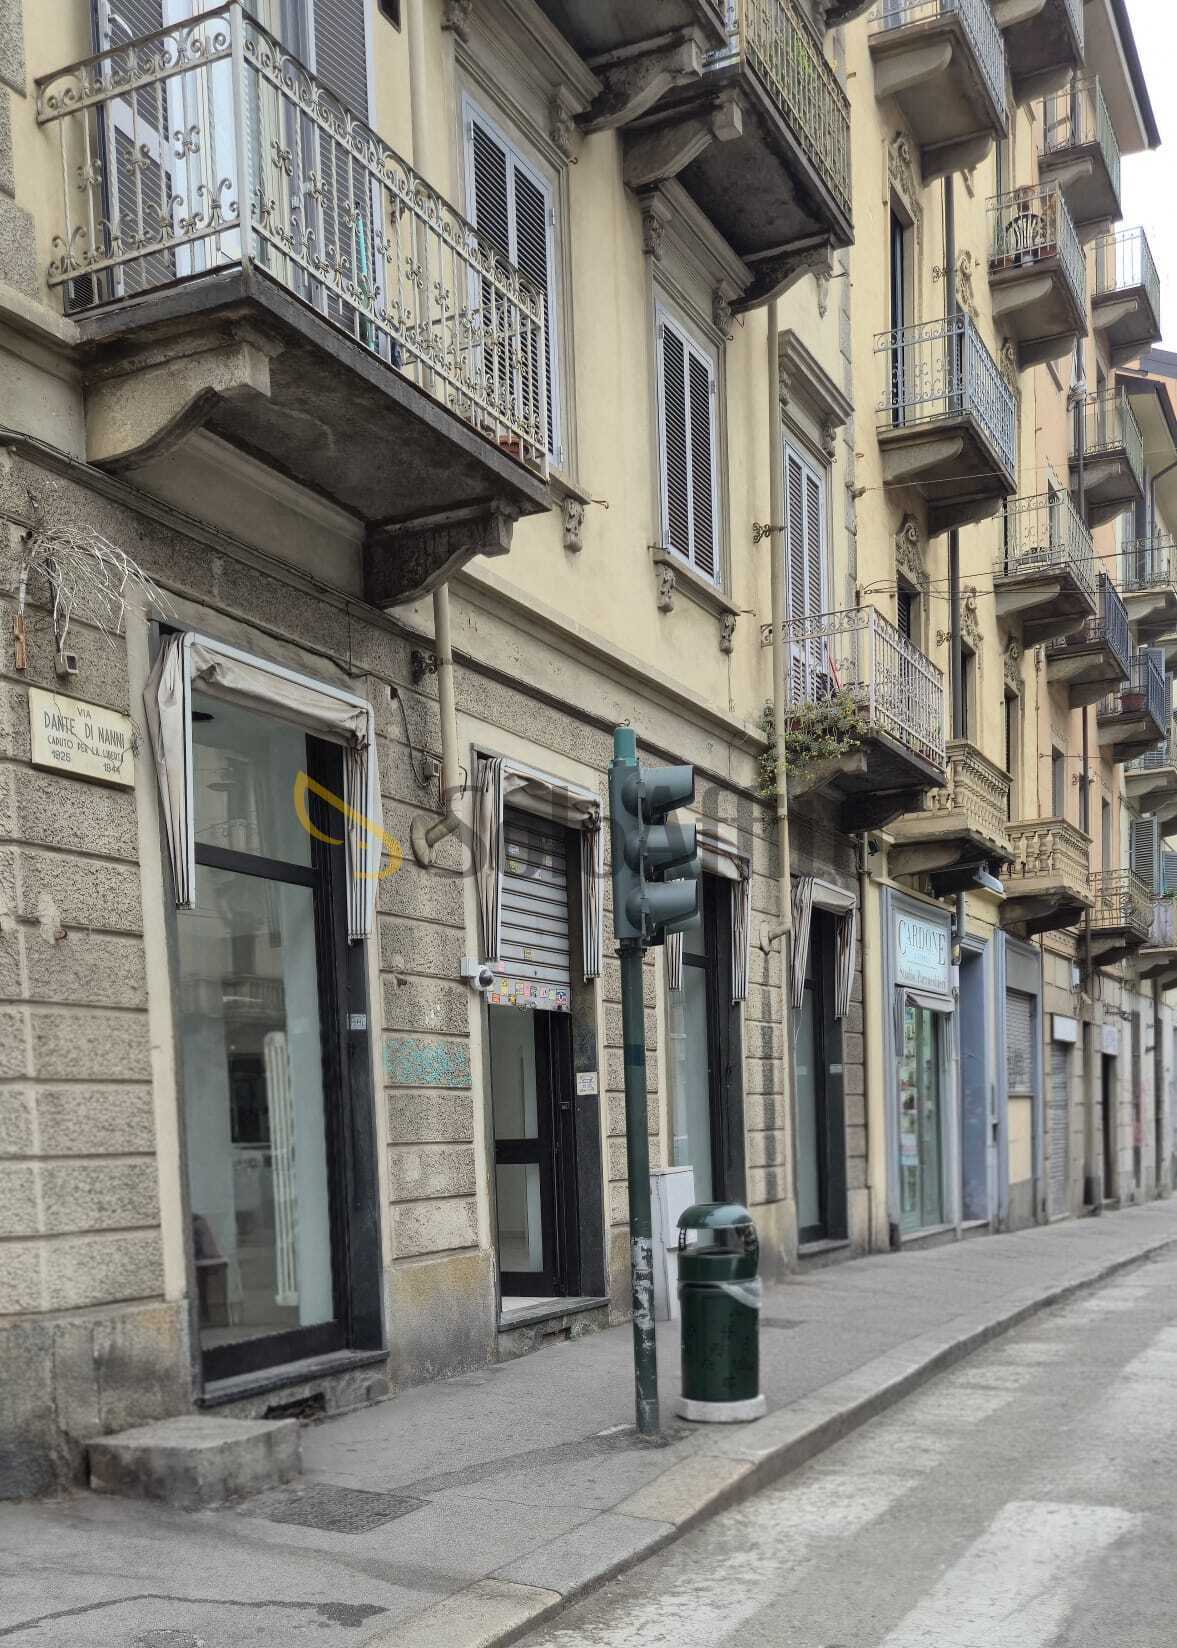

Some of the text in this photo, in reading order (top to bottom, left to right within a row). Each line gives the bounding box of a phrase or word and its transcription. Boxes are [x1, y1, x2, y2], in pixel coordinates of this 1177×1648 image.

[77, 706, 92, 719] VIA
[44, 711, 125, 749] DANTE DI NANNI
[48, 734, 74, 749] CADUTO
[78, 742, 88, 754] PER
